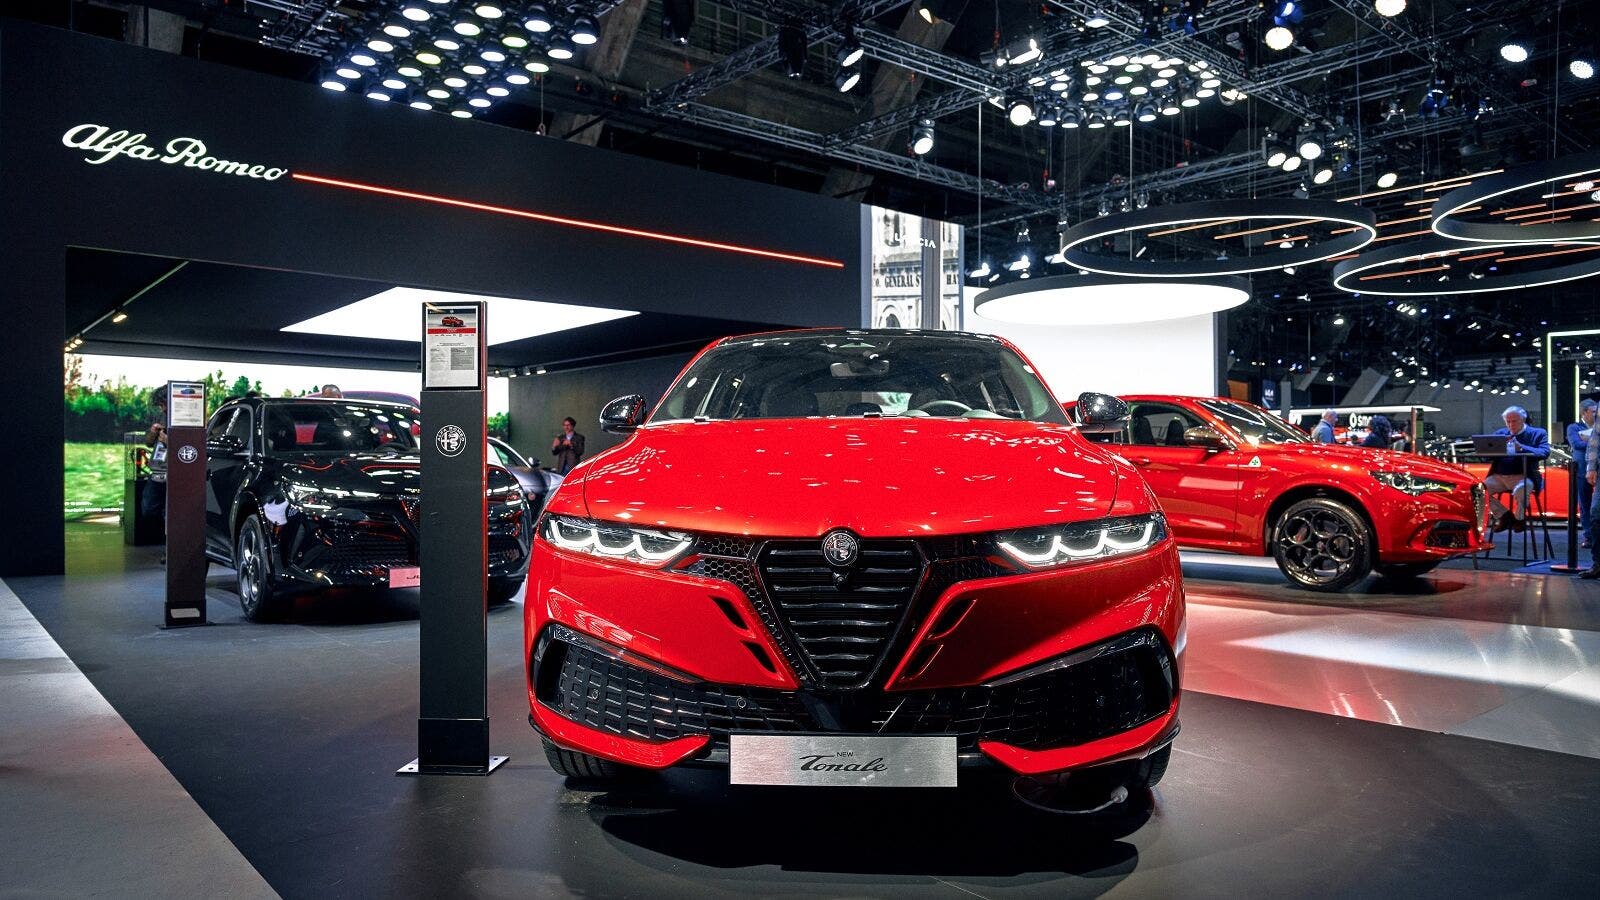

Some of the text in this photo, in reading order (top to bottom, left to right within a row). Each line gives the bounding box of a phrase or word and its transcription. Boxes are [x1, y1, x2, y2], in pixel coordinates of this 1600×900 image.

[62, 123, 288, 181] Alfa Romeo
[799, 754, 888, 773] Tonale
